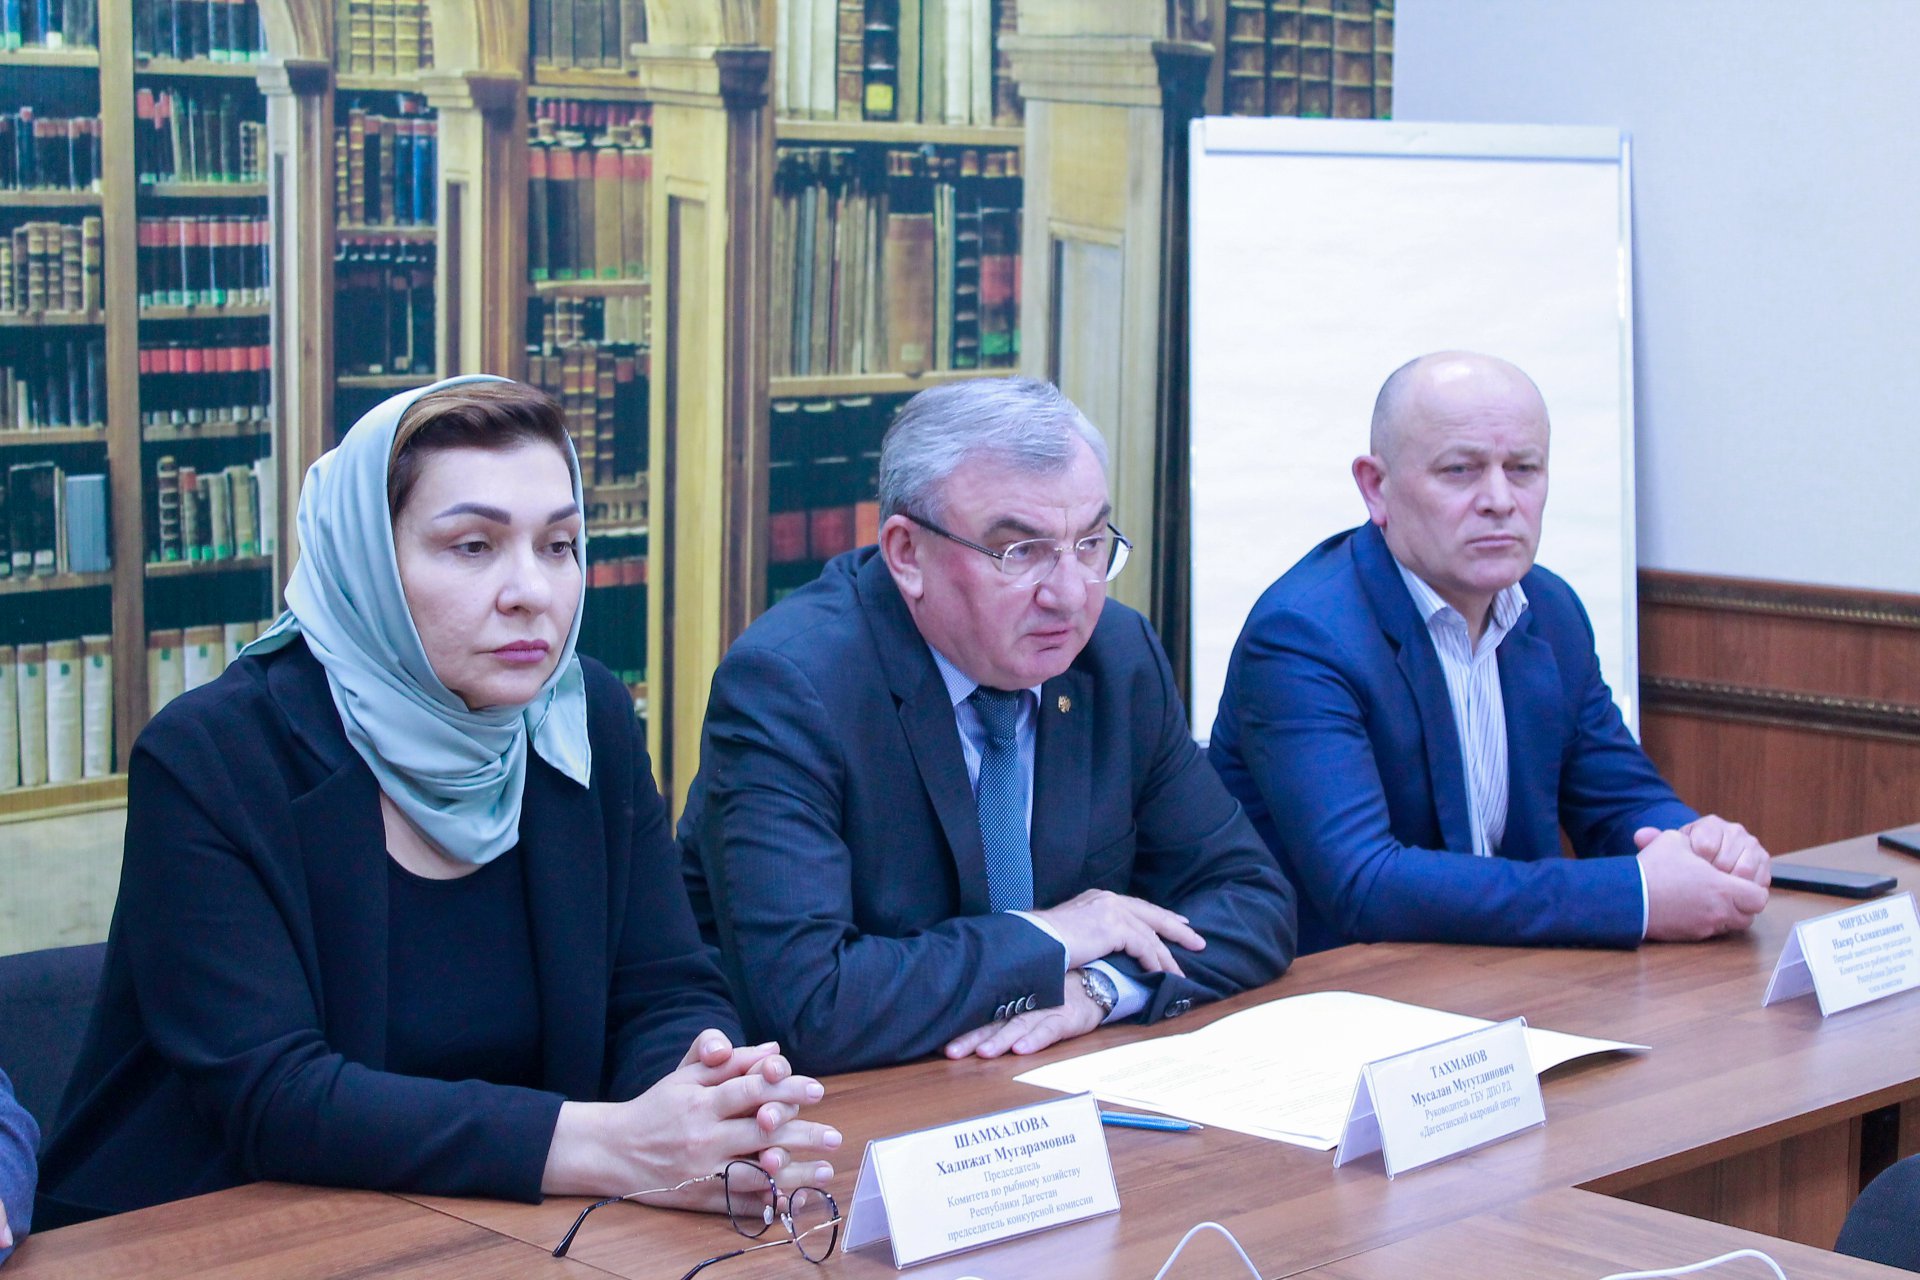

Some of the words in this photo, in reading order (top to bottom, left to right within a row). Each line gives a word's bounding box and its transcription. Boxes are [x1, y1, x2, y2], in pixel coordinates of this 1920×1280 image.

[1430, 1049, 1488, 1079] ТАХМАНОВ
[1452, 1063, 1515, 1095] Мугутдинович
[1424, 1098, 1471, 1120] Руководитель
[1470, 1089, 1485, 1105] ГБУ
[1501, 1080, 1513, 1093] РД
[1469, 1103, 1499, 1125] кадровый
[953, 1115, 1049, 1149] ШАМХАЛОВА
[936, 1154, 992, 1176] Хадижат
[993, 1132, 1076, 1163] Мугарамовна
[946, 1189, 990, 1208] Комитета
[990, 1187, 1002, 1198] по
[1002, 1176, 1040, 1195] рыбному
[1041, 1166, 1081, 1184] хозяйству
[983, 1161, 1041, 1182] Председатель
[947, 1218, 1006, 1241] председатель
[1006, 1205, 1055, 1226] конкурсной
[1055, 1194, 1094, 1212] комиссии
[969, 1198, 1021, 1219] Республики
[1021, 1188, 1058, 1208] Дагестан
